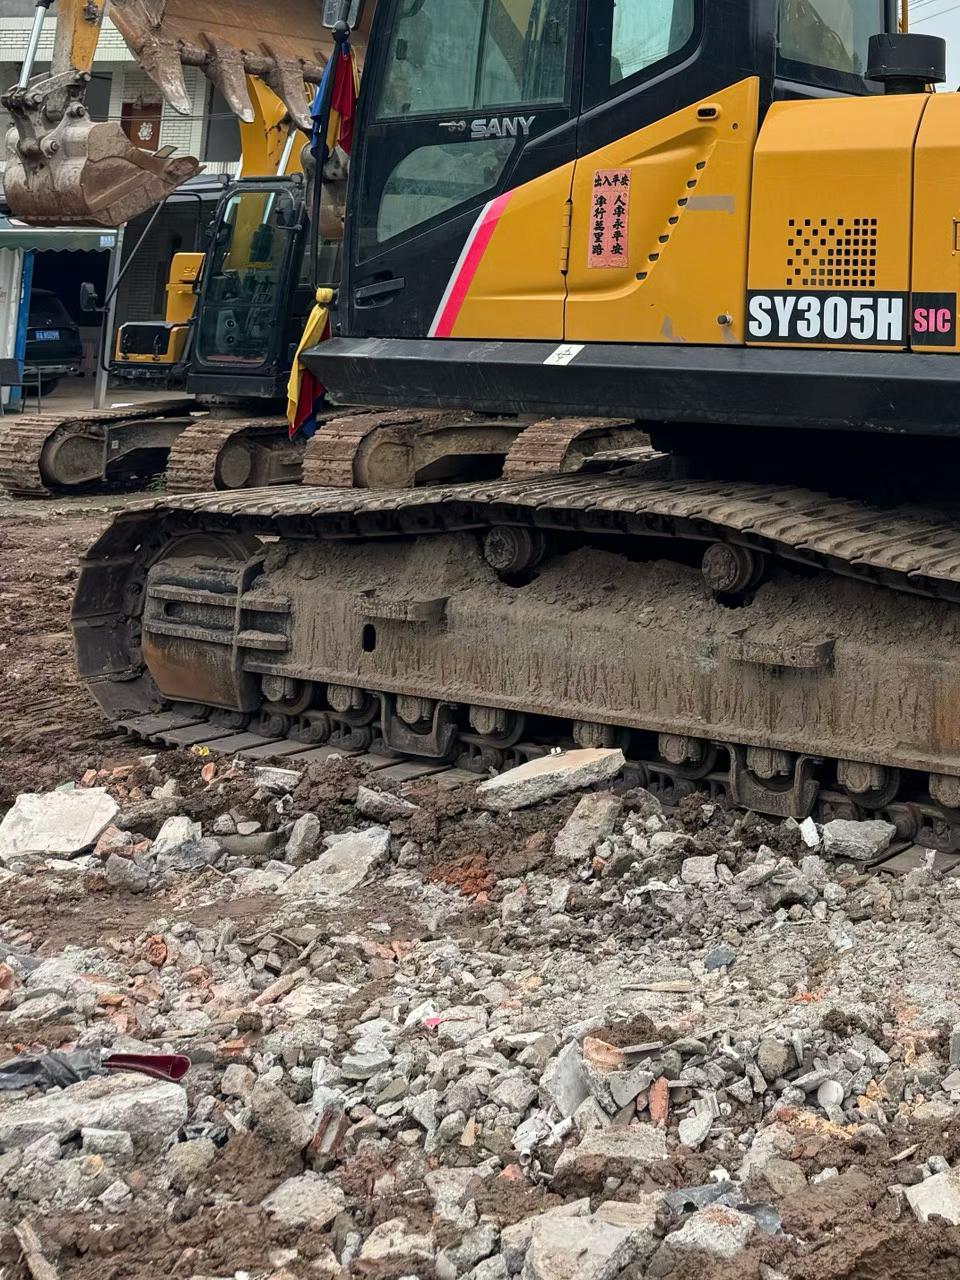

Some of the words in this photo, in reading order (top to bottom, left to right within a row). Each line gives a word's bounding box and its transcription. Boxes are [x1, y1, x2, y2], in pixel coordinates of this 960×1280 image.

[471, 116, 536, 138] SANY
[594, 173, 629, 187] 出入平安
[610, 194, 626, 255] 人車永平安
[749, 295, 903, 341] SY305H
[913, 308, 951, 333] SIC
